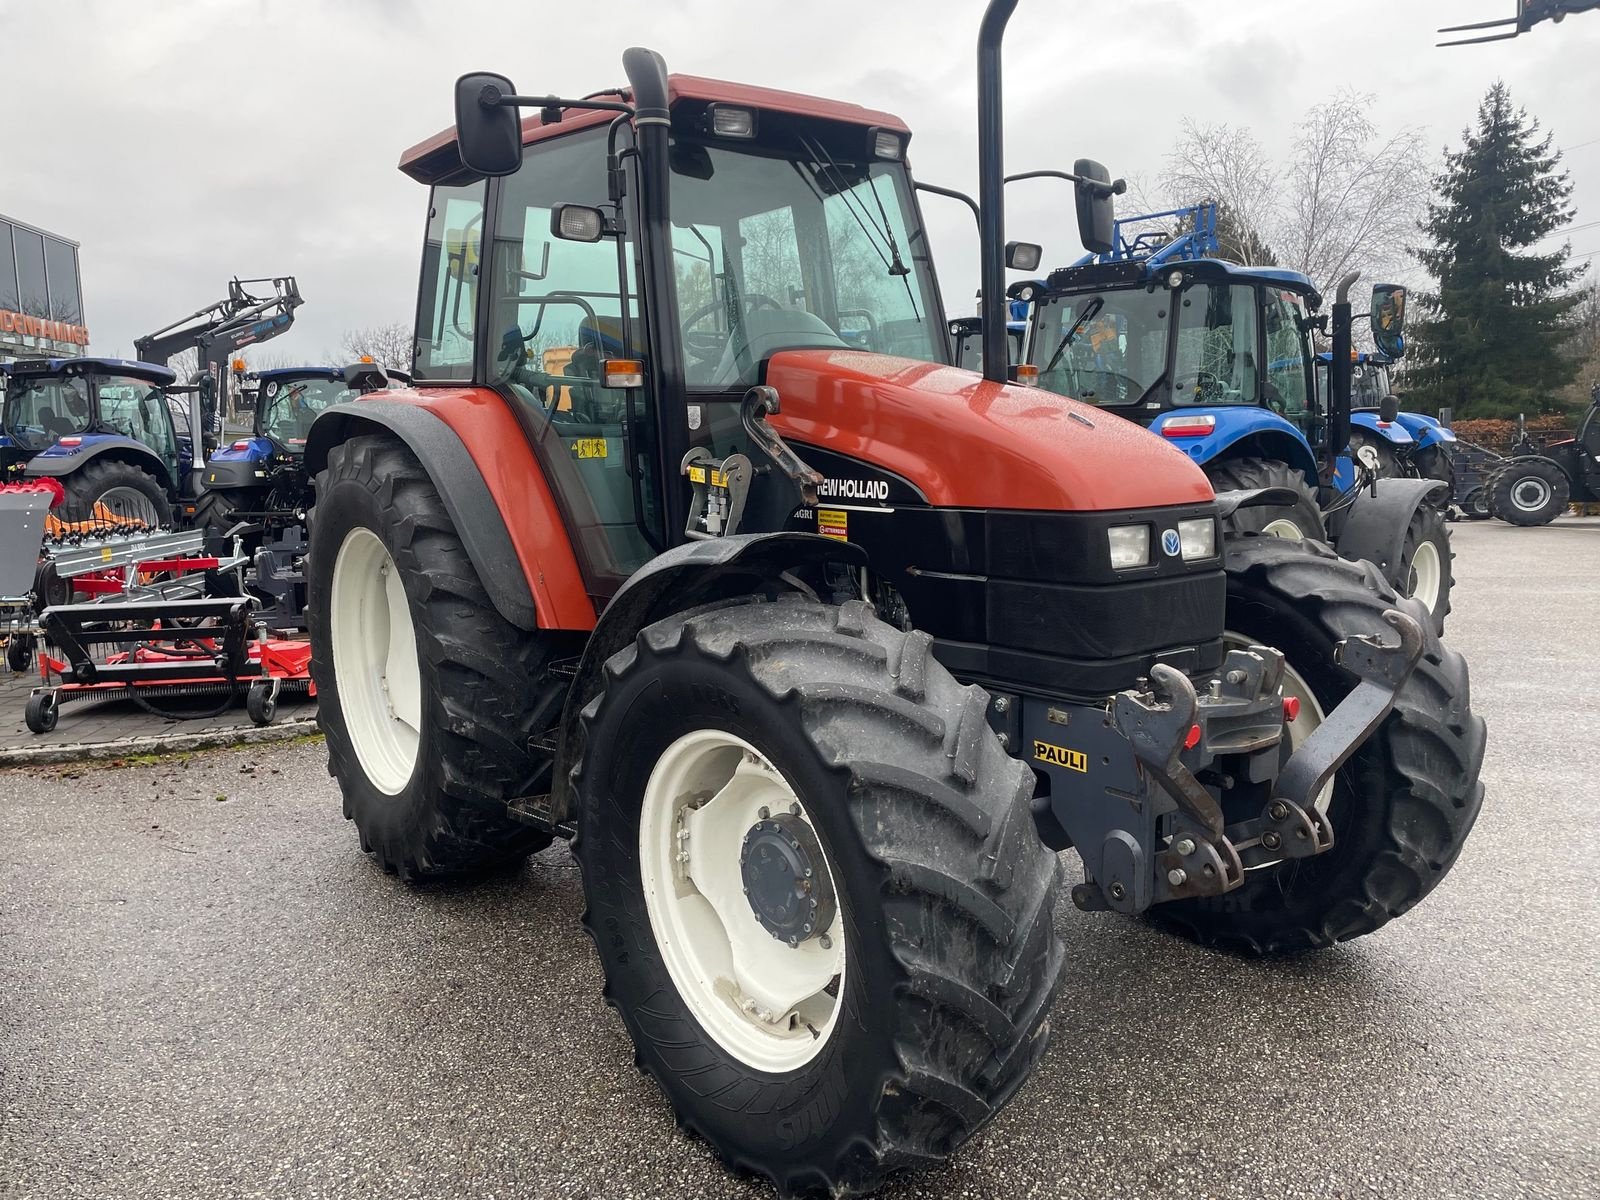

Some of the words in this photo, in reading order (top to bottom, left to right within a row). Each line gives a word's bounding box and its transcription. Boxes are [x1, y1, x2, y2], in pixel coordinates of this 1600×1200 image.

[839, 479, 889, 500] HOLLAND
[793, 509, 813, 519] AGRI
[1036, 743, 1084, 770] PAULI
